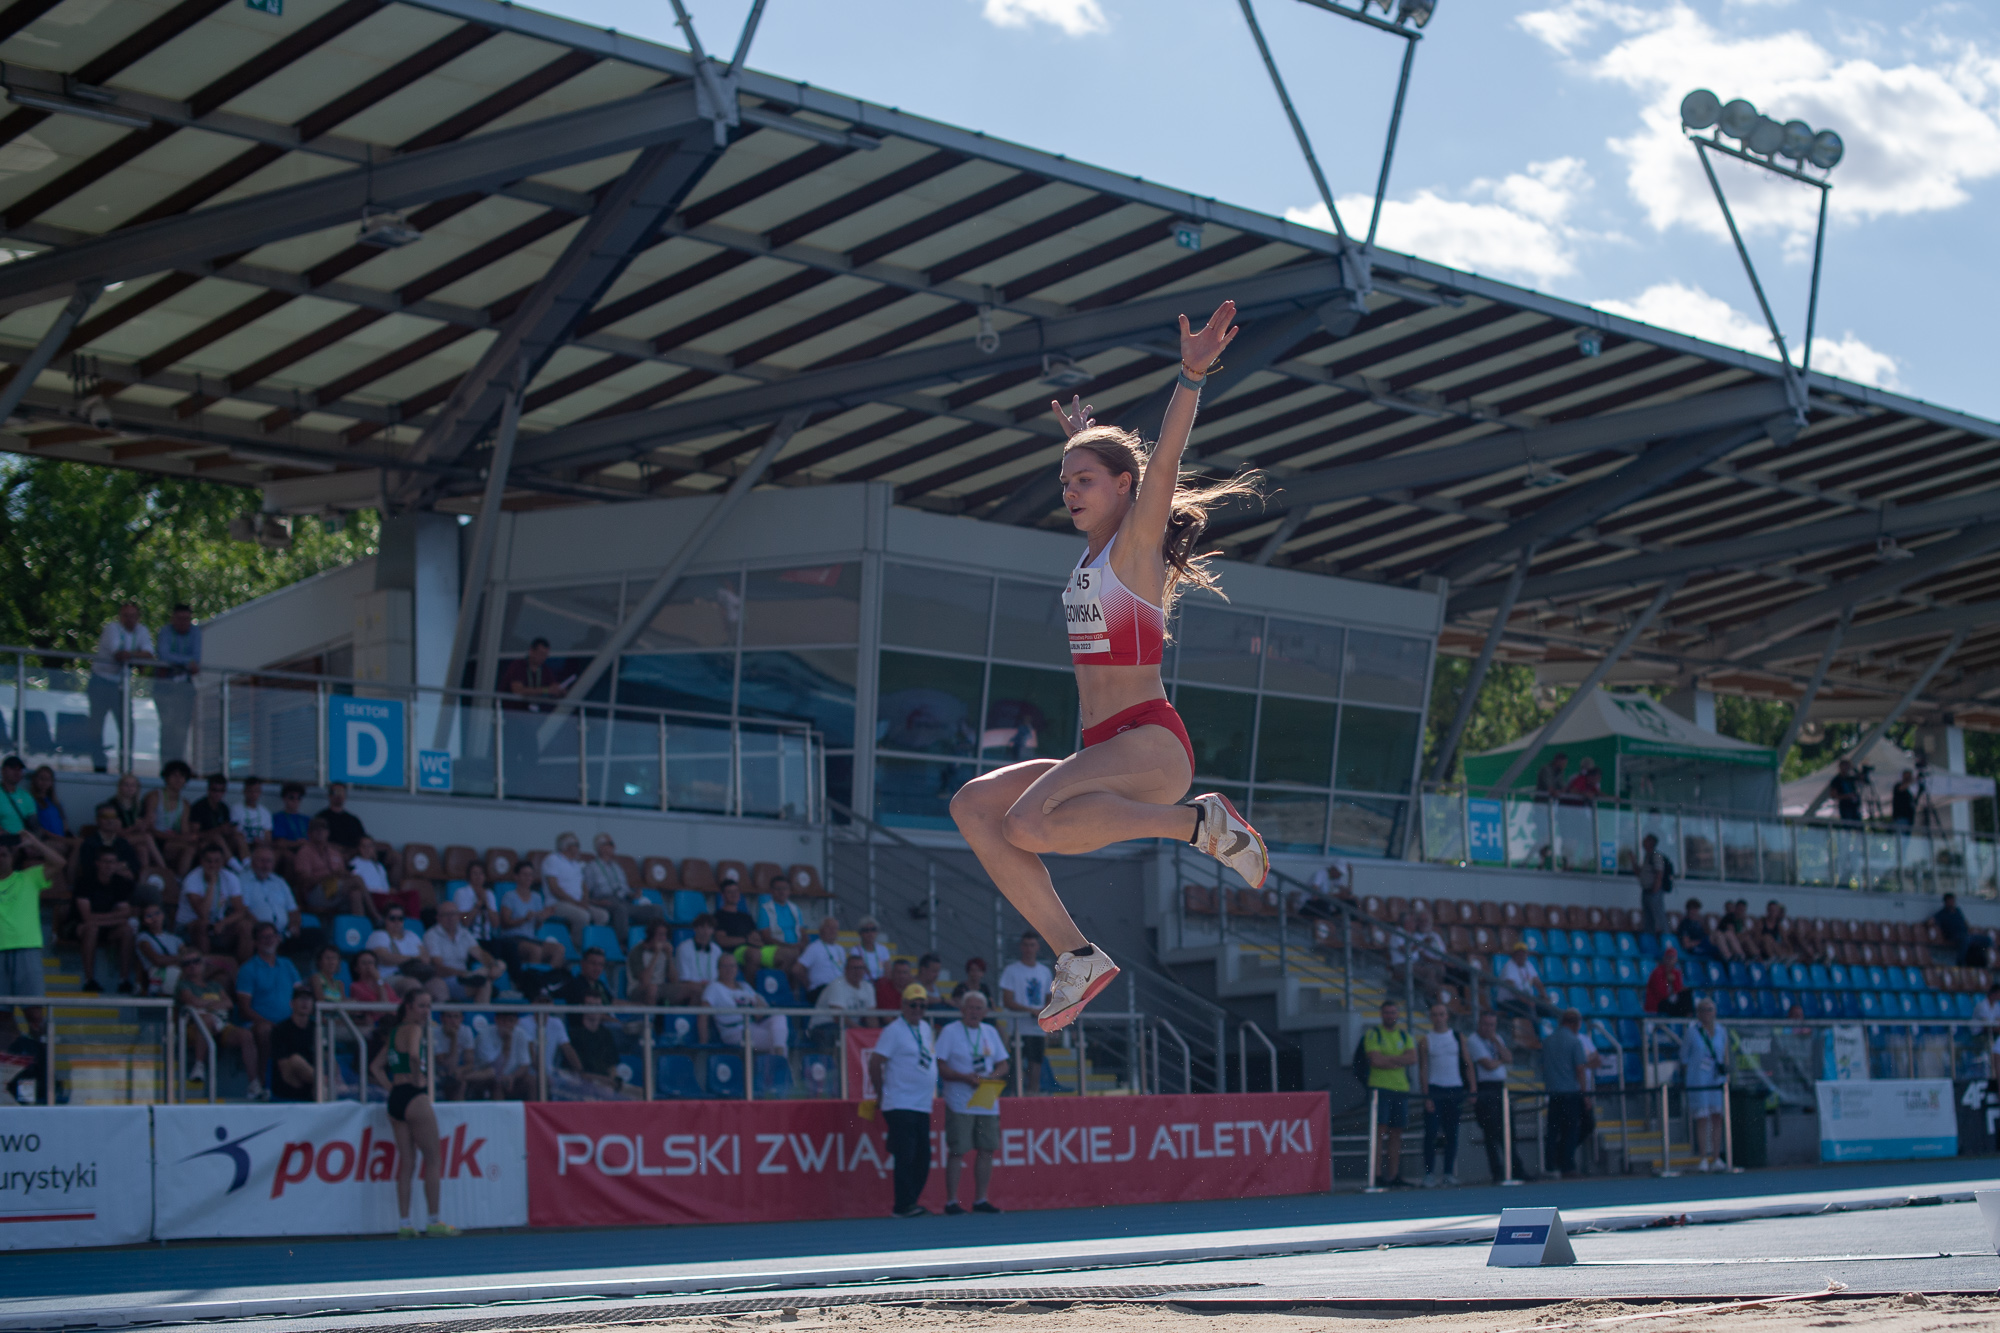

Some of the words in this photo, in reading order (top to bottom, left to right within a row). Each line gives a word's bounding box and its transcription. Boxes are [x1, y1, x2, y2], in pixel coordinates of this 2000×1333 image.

[1077, 574, 1090, 590] 45
[1066, 604, 1102, 622] GOWSKA
[1080, 642, 1091, 650] 2023
[343, 703, 390, 718] SEKTOR
[347, 721, 388, 776] D
[421, 755, 450, 774] WC
[1470, 820, 1502, 849] E-H
[556, 1132, 742, 1177] POLSKI
[991, 1125, 1137, 1168] EKKIEJ
[1149, 1118, 1315, 1160] ATLETYKI
